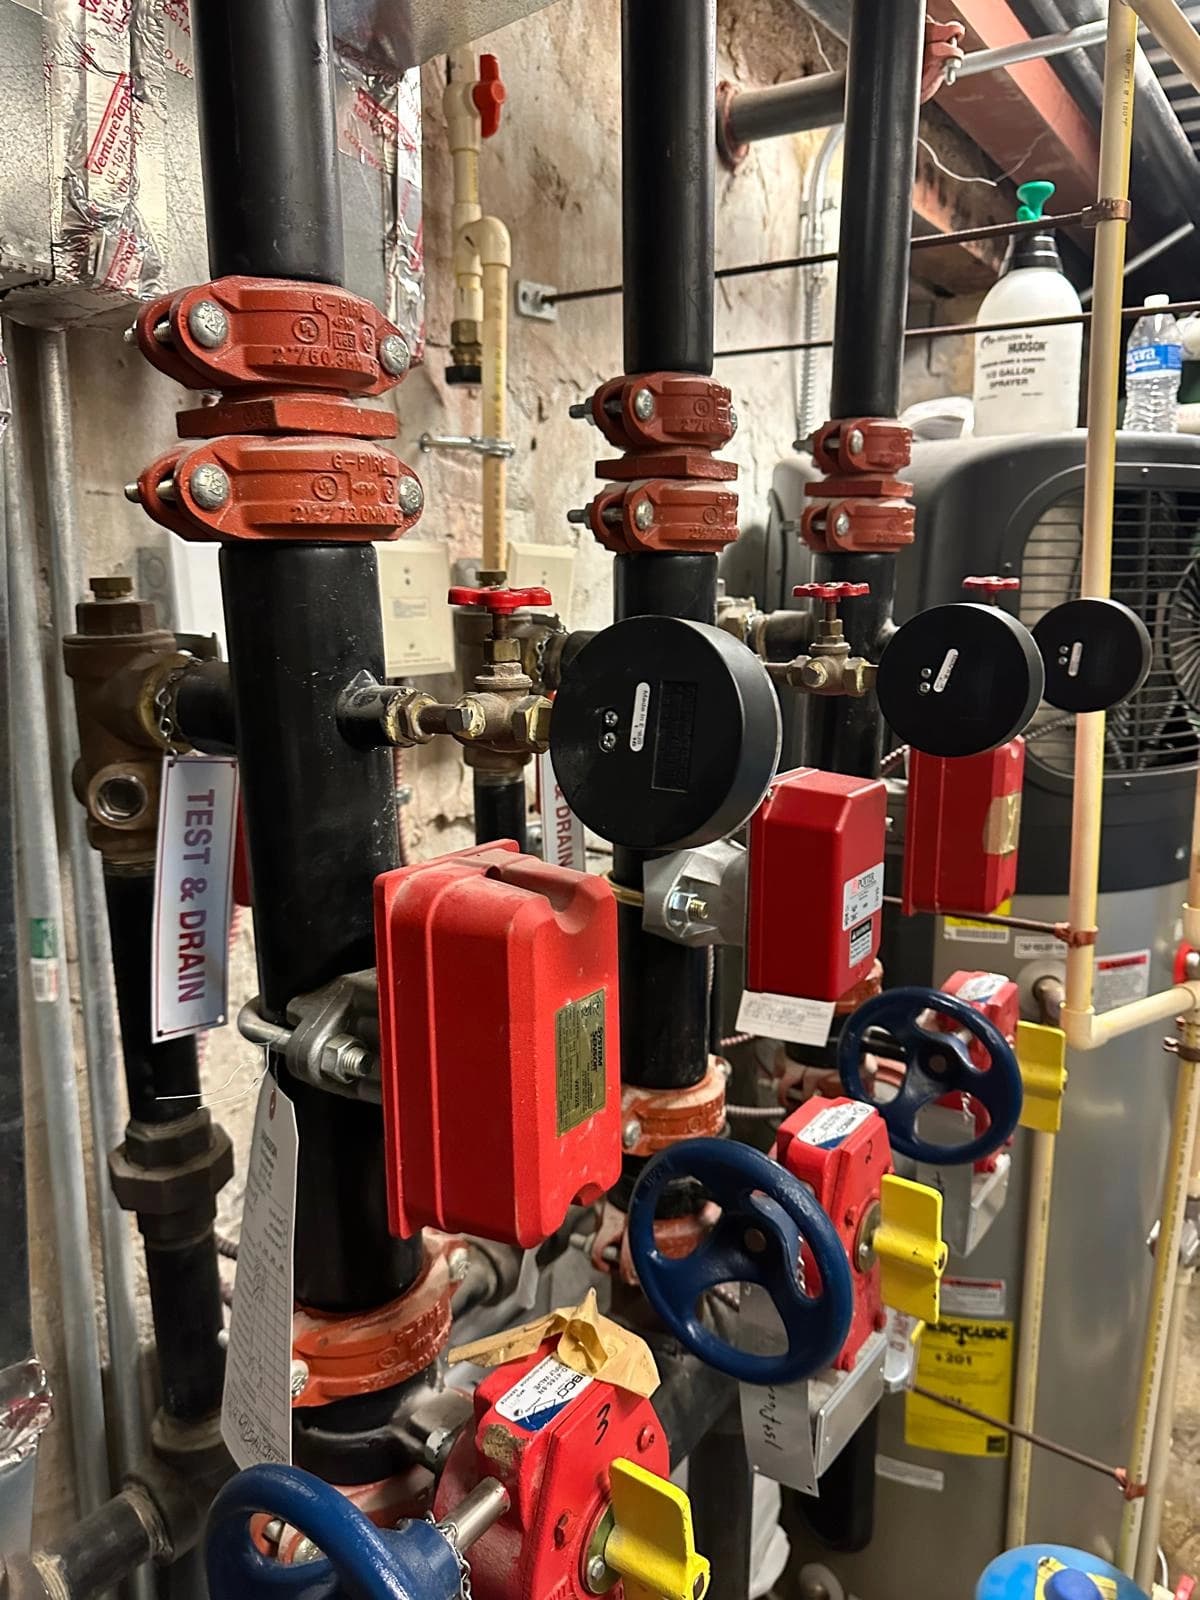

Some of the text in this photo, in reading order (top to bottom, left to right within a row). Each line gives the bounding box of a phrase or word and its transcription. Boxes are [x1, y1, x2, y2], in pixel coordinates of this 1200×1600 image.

[1007, 341, 1046, 354] HUDSON
[556, 805, 574, 867] DRAIN
[178, 788, 215, 1003] TEST & DRAIN
[594, 1402, 611, 1446] 3
